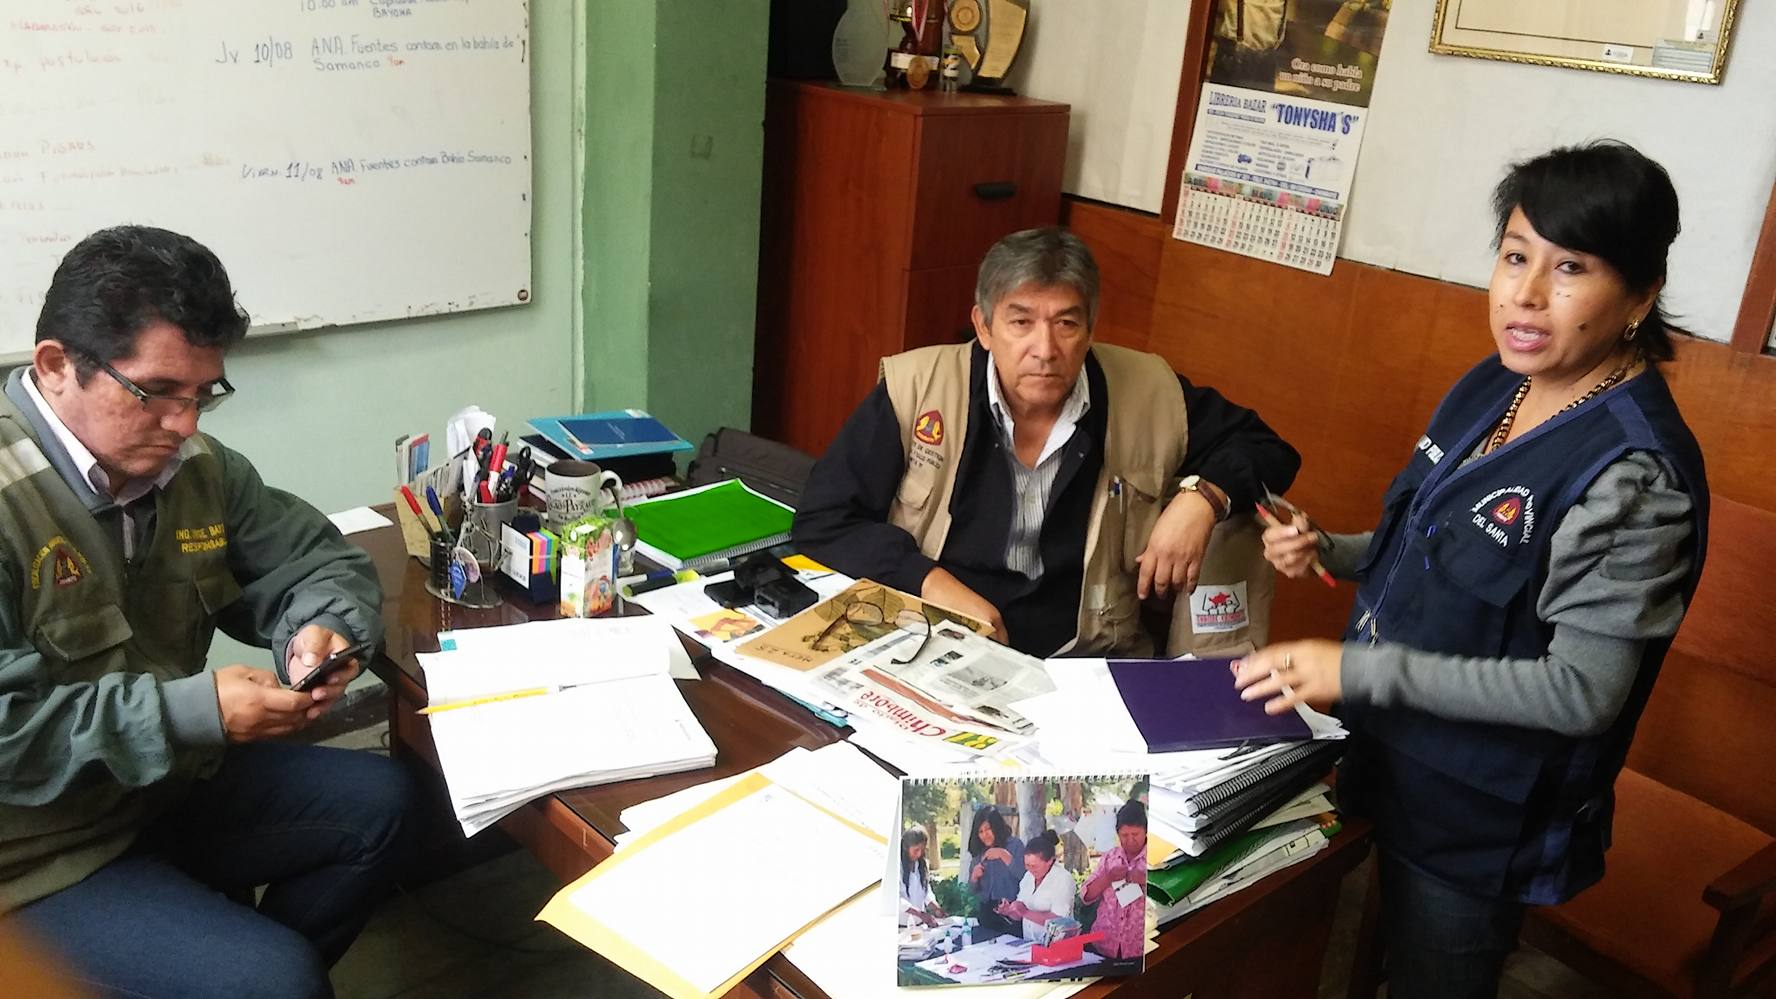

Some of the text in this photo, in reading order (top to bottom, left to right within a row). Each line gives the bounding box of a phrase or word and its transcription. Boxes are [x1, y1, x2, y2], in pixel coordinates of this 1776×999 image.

[253, 36, 294, 68] 10/08
[351, 34, 399, 54] Fuentes
[313, 58, 381, 72] Samanco
[1311, 63, 1338, 75] como
[1471, 485, 1535, 545] MUNICIPALIDAD PROVINCIAL
[1472, 513, 1510, 547] DEL SANTA
